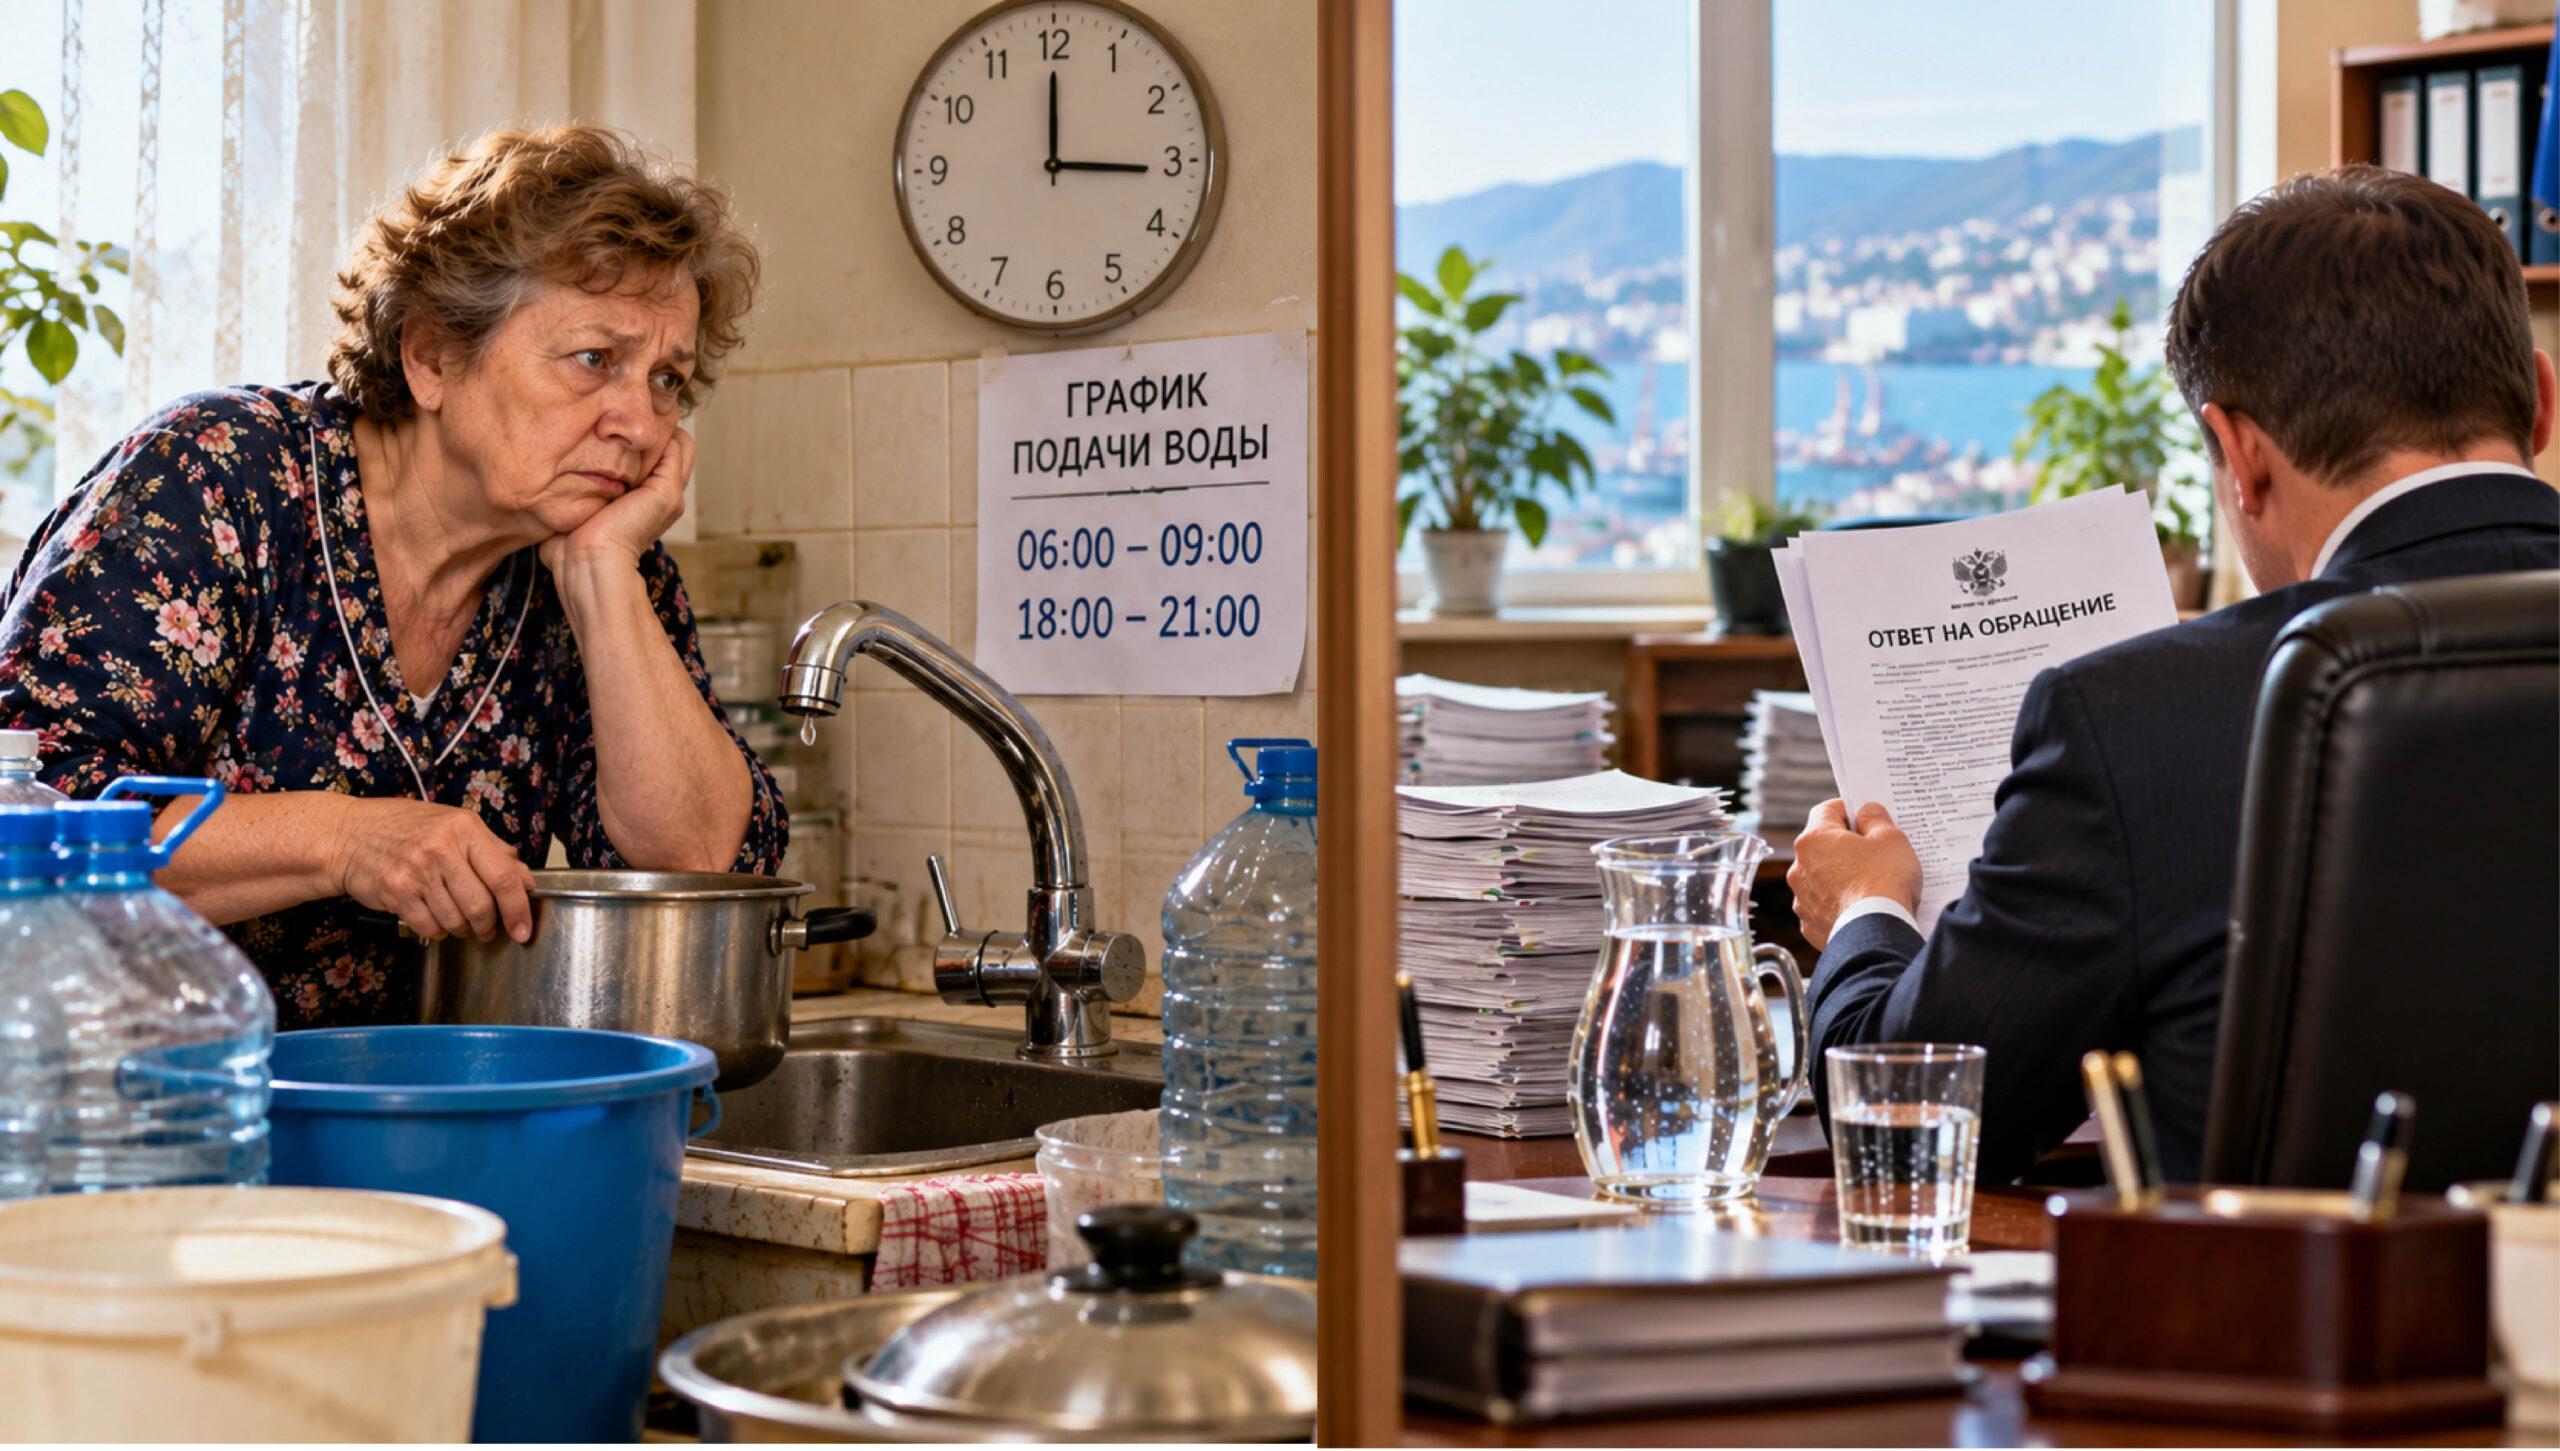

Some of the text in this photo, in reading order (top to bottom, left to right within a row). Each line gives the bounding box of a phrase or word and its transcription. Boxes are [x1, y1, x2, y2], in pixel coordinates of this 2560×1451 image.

[1037, 28, 1071, 62] 12
[1107, 42, 1118, 74] 1
[984, 48, 1008, 80] 11
[943, 94, 975, 125] 10
[1146, 84, 1166, 115] 2
[929, 155, 949, 186] 9
[1163, 145, 1183, 177] 3
[946, 215, 966, 246] 8
[1145, 207, 1167, 238] 4
[989, 255, 1009, 287] 7
[1104, 252, 1123, 284] 5
[1045, 269, 1066, 301] 6
[1066, 371, 1209, 419] ГРАФИК
[1012, 423, 1270, 479] ПОДАЧИ ВОДЫ
[1016, 526, 1116, 572] 06:00
[1159, 520, 1264, 567] 09:00
[1017, 596, 1115, 641] 18:00
[1158, 593, 1262, 639] 21:00
[1867, 625, 1937, 649] ОТВЕТ
[1942, 621, 1976, 642] НА
[1978, 592, 2117, 637] ОБРАЩЕНИЕ
